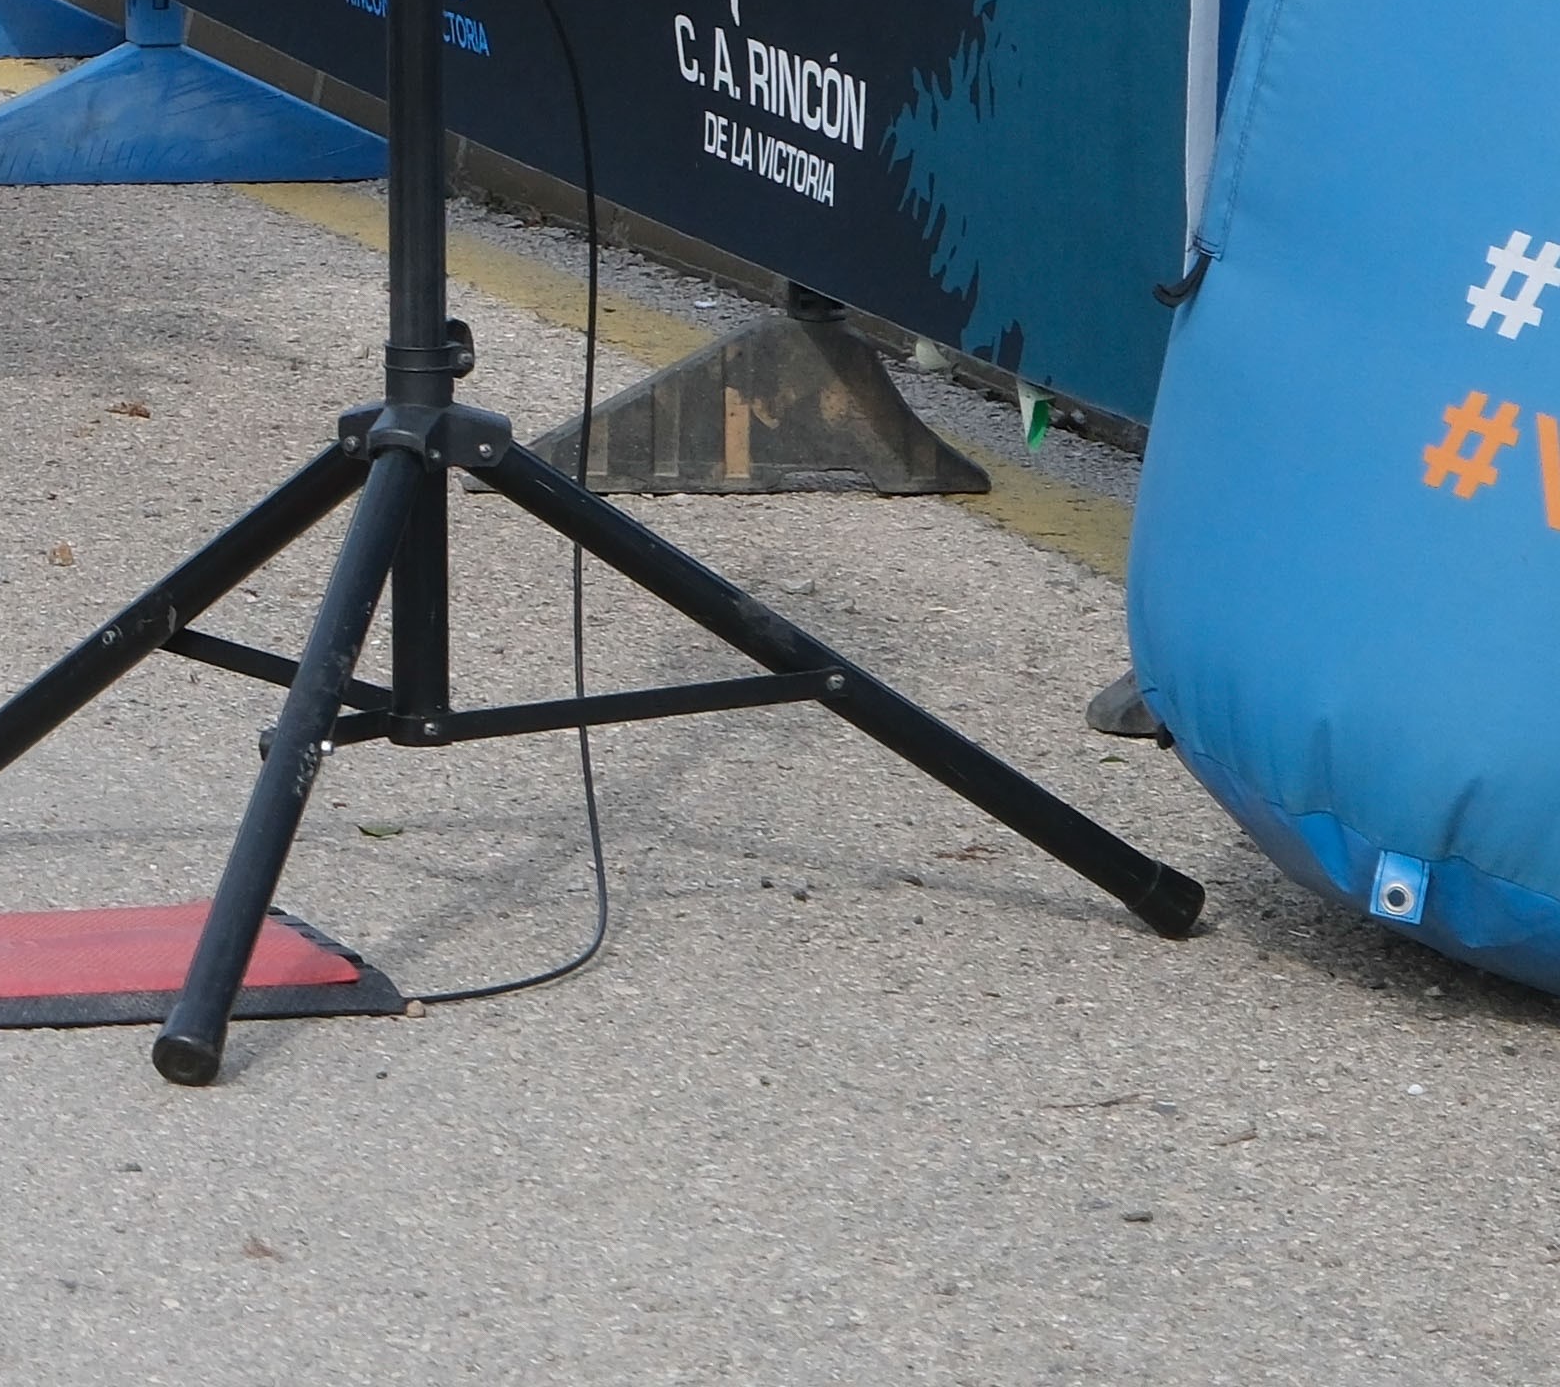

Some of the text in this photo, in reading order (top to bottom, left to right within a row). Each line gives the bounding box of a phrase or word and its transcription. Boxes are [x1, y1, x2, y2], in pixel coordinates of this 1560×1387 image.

[674, 15, 866, 152] C. A. RINCÓN
[704, 111, 835, 207] DE LA VICTORIA
